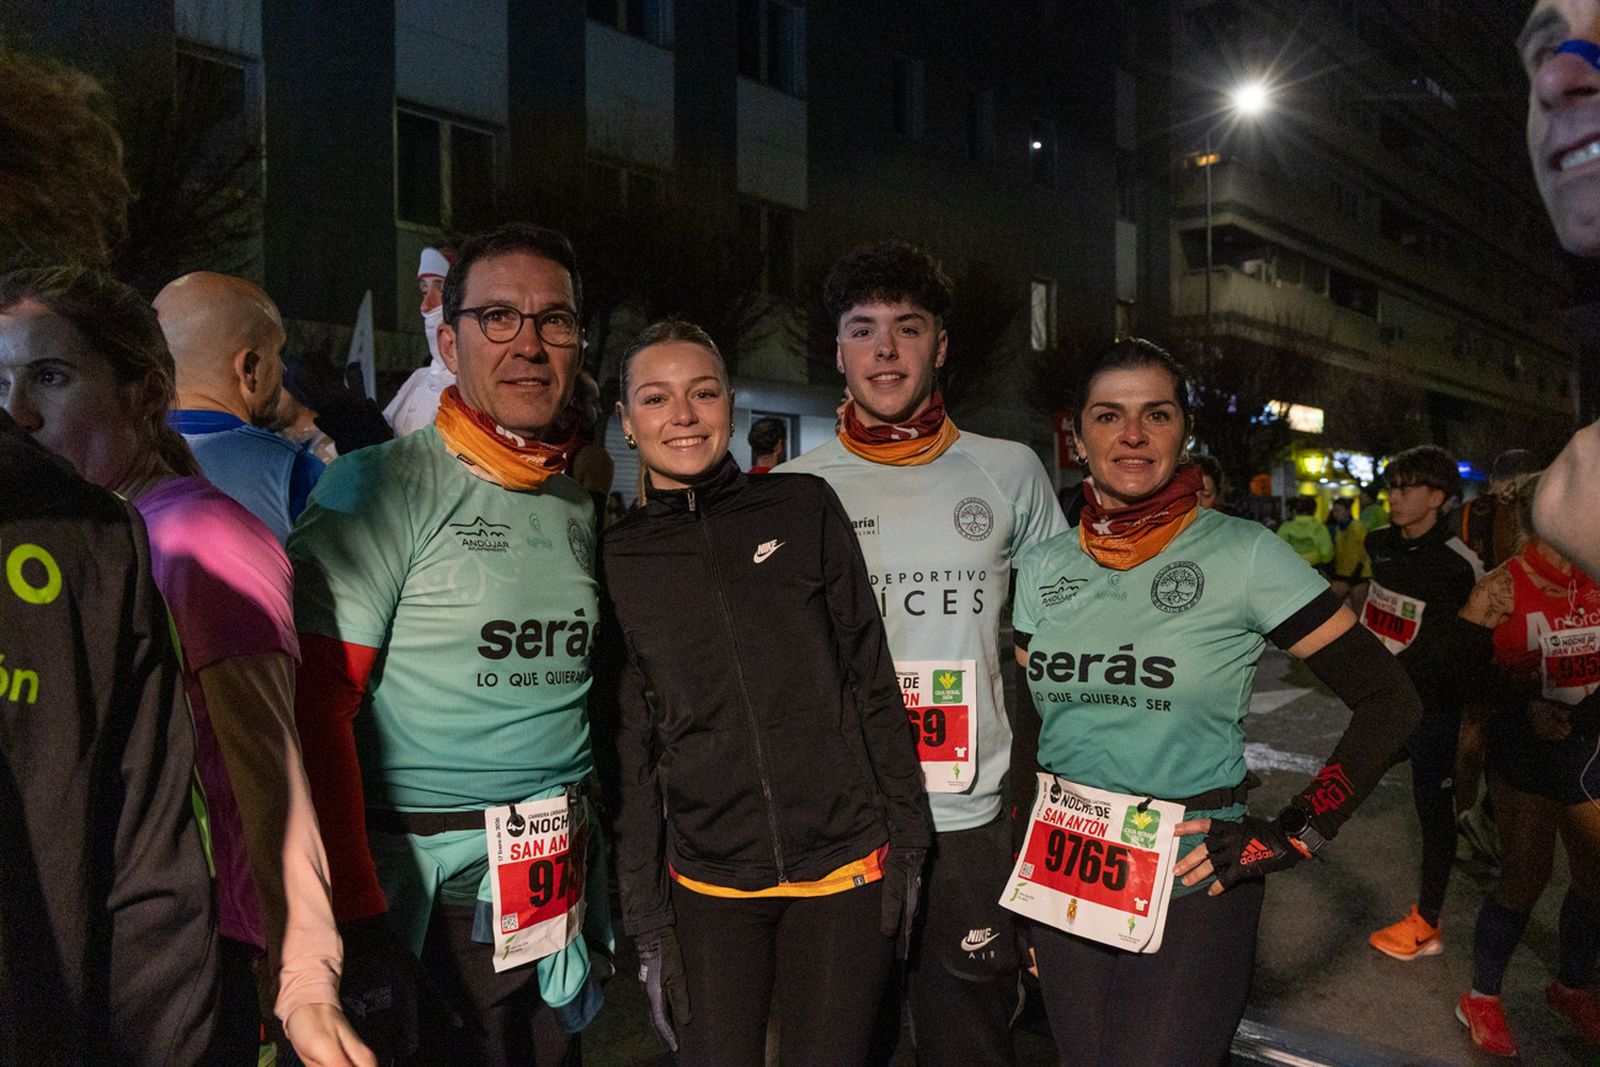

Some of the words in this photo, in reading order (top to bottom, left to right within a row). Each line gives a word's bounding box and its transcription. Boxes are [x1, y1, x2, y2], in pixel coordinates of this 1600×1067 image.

[462, 538, 510, 548] ANDÚJAR
[870, 570, 987, 585] DEPORTIVO
[1028, 643, 1177, 689] serás
[477, 673, 498, 687] LO
[509, 672, 539, 687] QUE
[903, 677, 920, 689] DE
[1047, 692, 1073, 704] QUE
[1080, 692, 1137, 708] QUIERAS
[1146, 699, 1172, 712] SER
[1060, 794, 1094, 815] NOCHE
[1095, 805, 1112, 819] DE
[528, 812, 549, 820] CARRERA
[1043, 807, 1067, 824] SAN
[1066, 817, 1109, 838] ANTÓN
[511, 839, 545, 860] SAN
[549, 832, 568, 854] AN
[1045, 829, 1130, 892] 9765
[1240, 849, 1275, 865] adidas
[967, 928, 992, 943] NIKE
[968, 950, 996, 960] AIR
